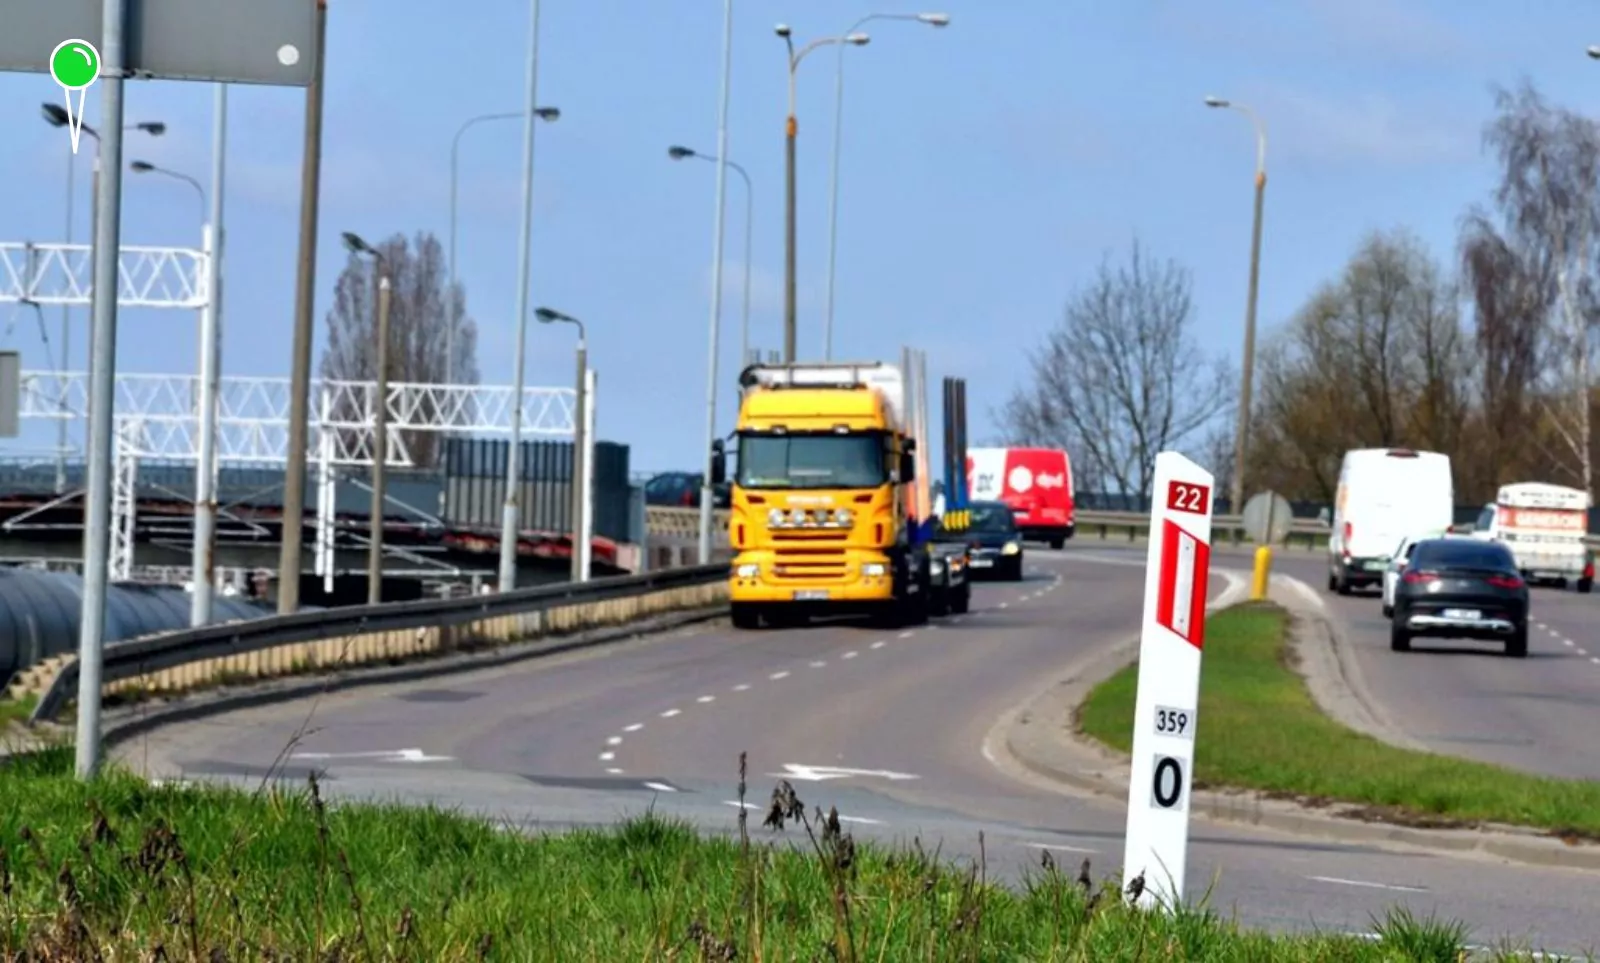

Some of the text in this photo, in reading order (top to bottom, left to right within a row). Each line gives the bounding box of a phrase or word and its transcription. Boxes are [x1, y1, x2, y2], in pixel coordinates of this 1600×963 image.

[1174, 485, 1201, 510] 22
[1157, 710, 1187, 734] 359
[1154, 756, 1182, 808] 0
